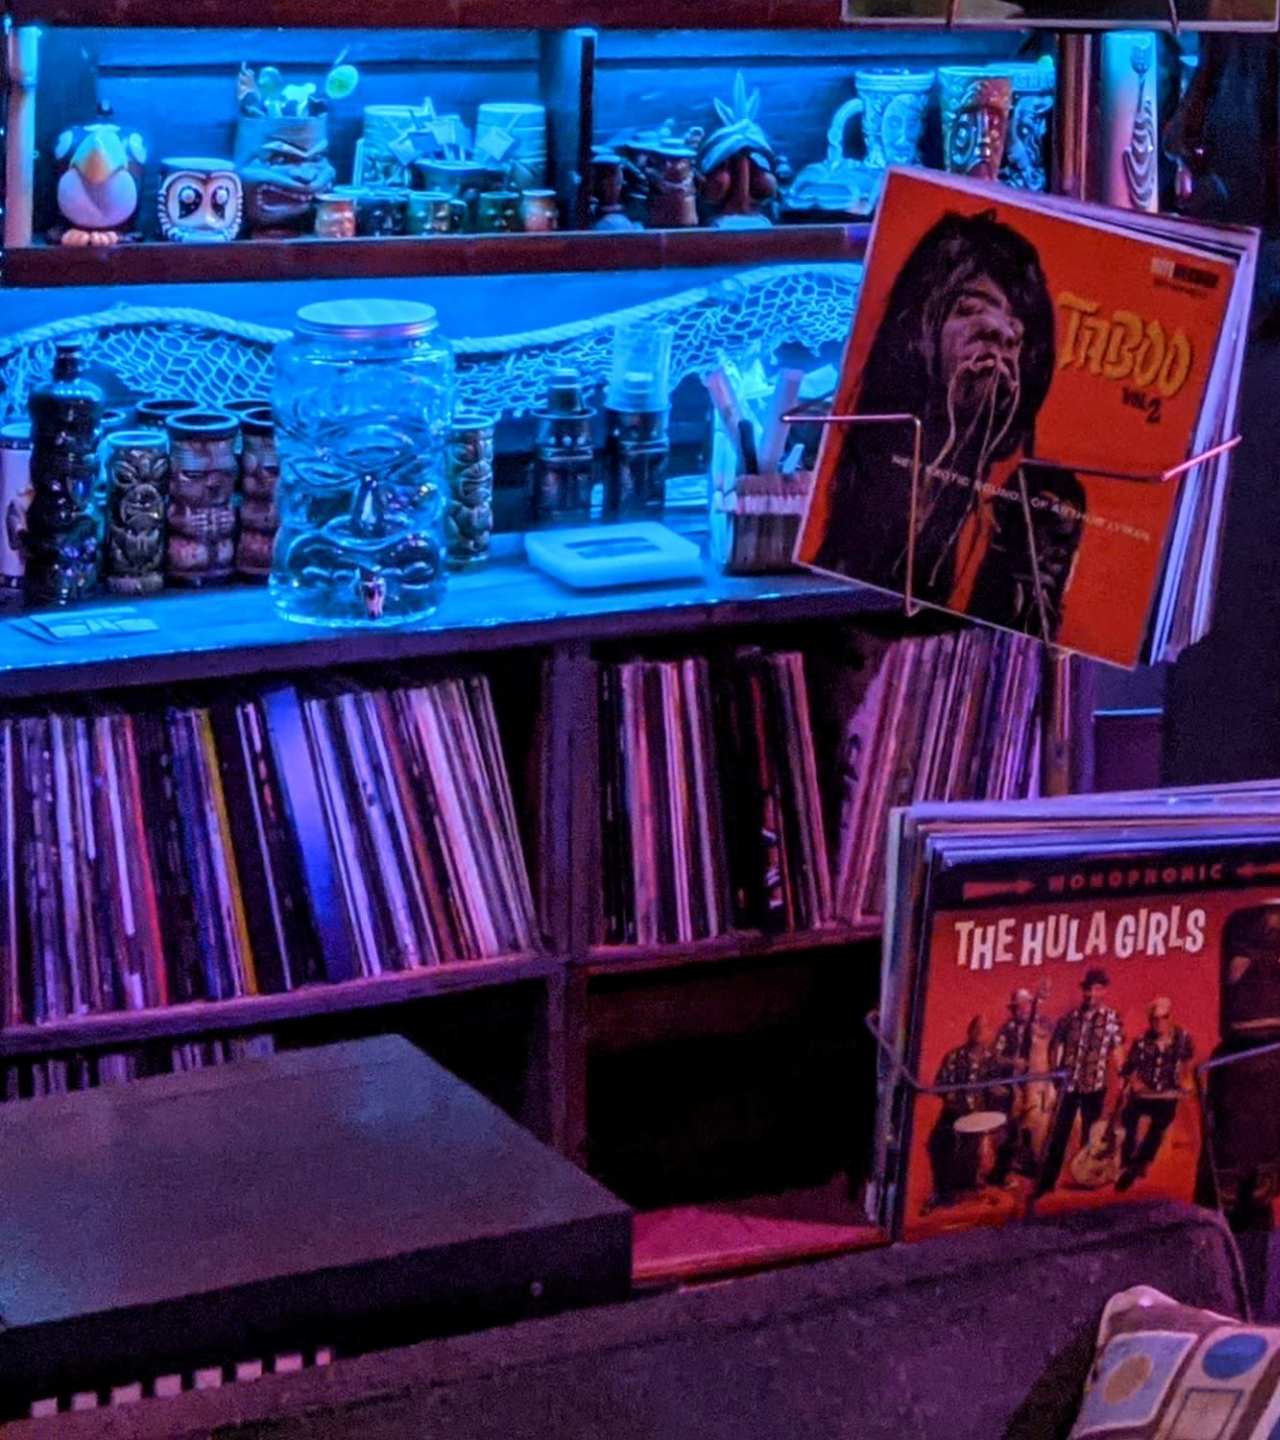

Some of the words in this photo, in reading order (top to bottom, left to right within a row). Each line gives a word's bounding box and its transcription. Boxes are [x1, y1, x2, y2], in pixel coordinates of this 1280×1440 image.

[1146, 397, 1162, 424] 2
[1030, 497, 1048, 509] OF
[1048, 864, 1222, 892] MONOPHONIC
[954, 918, 1017, 971] THE
[1020, 911, 1108, 967] HULA
[1114, 905, 1207, 960] GIRLS
